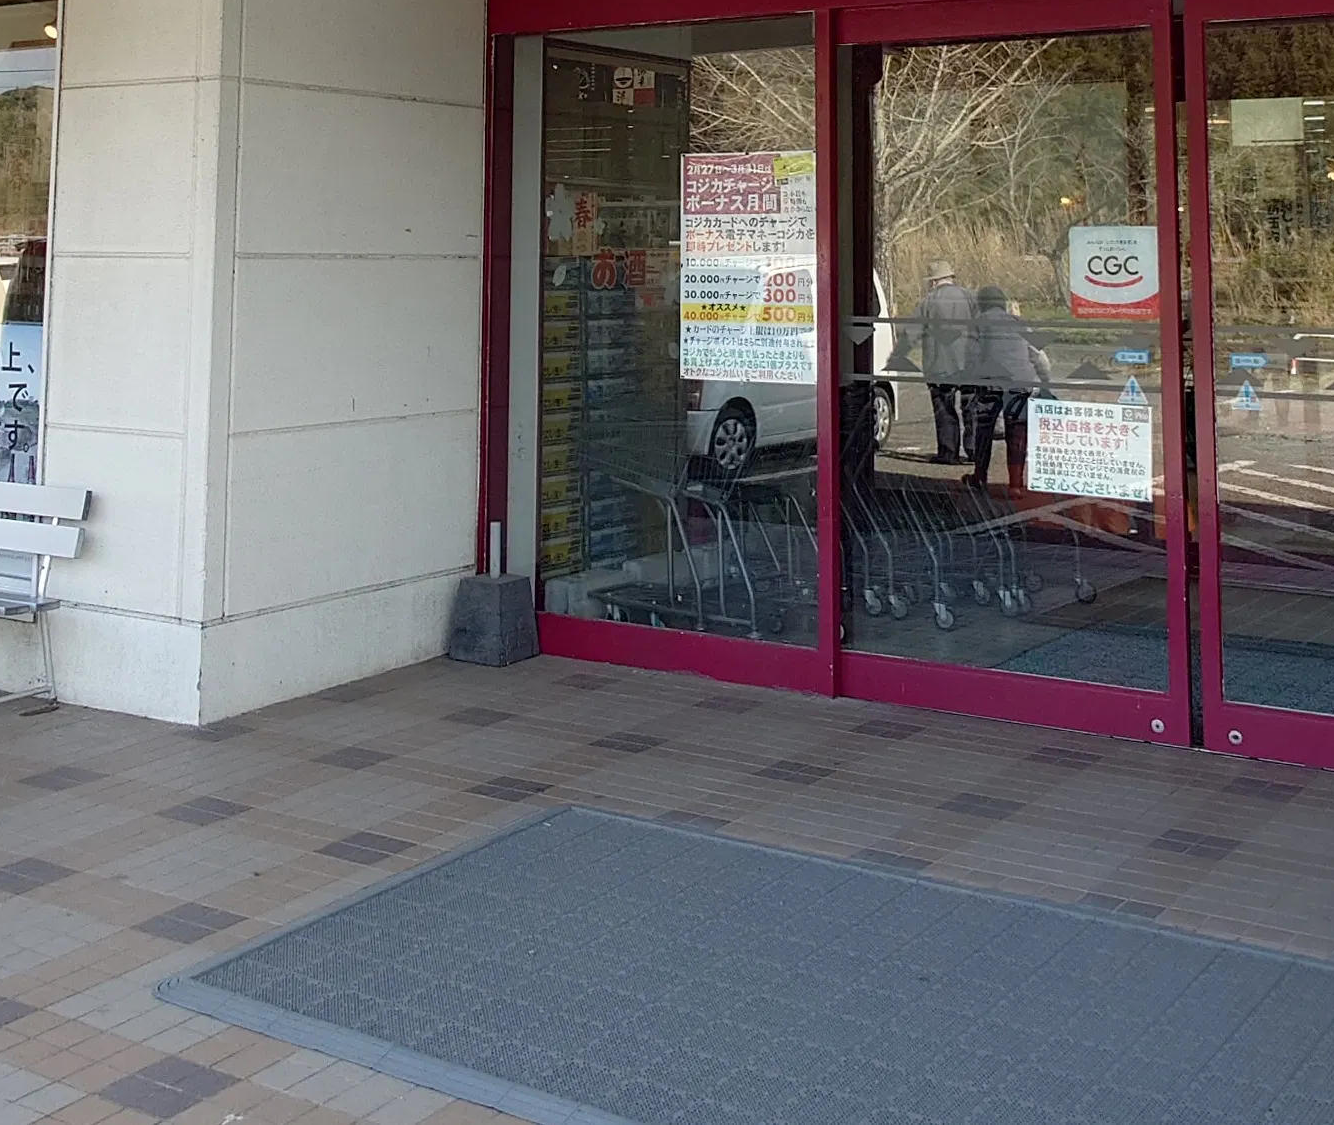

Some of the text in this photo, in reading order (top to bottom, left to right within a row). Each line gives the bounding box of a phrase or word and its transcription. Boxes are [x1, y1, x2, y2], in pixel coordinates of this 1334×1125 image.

[686, 177, 773, 194] コジカチャージ
[686, 194, 778, 212] ボーナス月間
[685, 216, 807, 228] コジカカードへのチャージで
[686, 229, 815, 240] ボーナス電子マネーコジカを
[592, 246, 646, 290] お酒
[1087, 255, 1139, 275] CGC
[1035, 404, 1115, 419] 当店はお客様本位
[1039, 417, 1140, 438] 税込価格を大きく
[1039, 431, 1129, 451] 表示しています!
